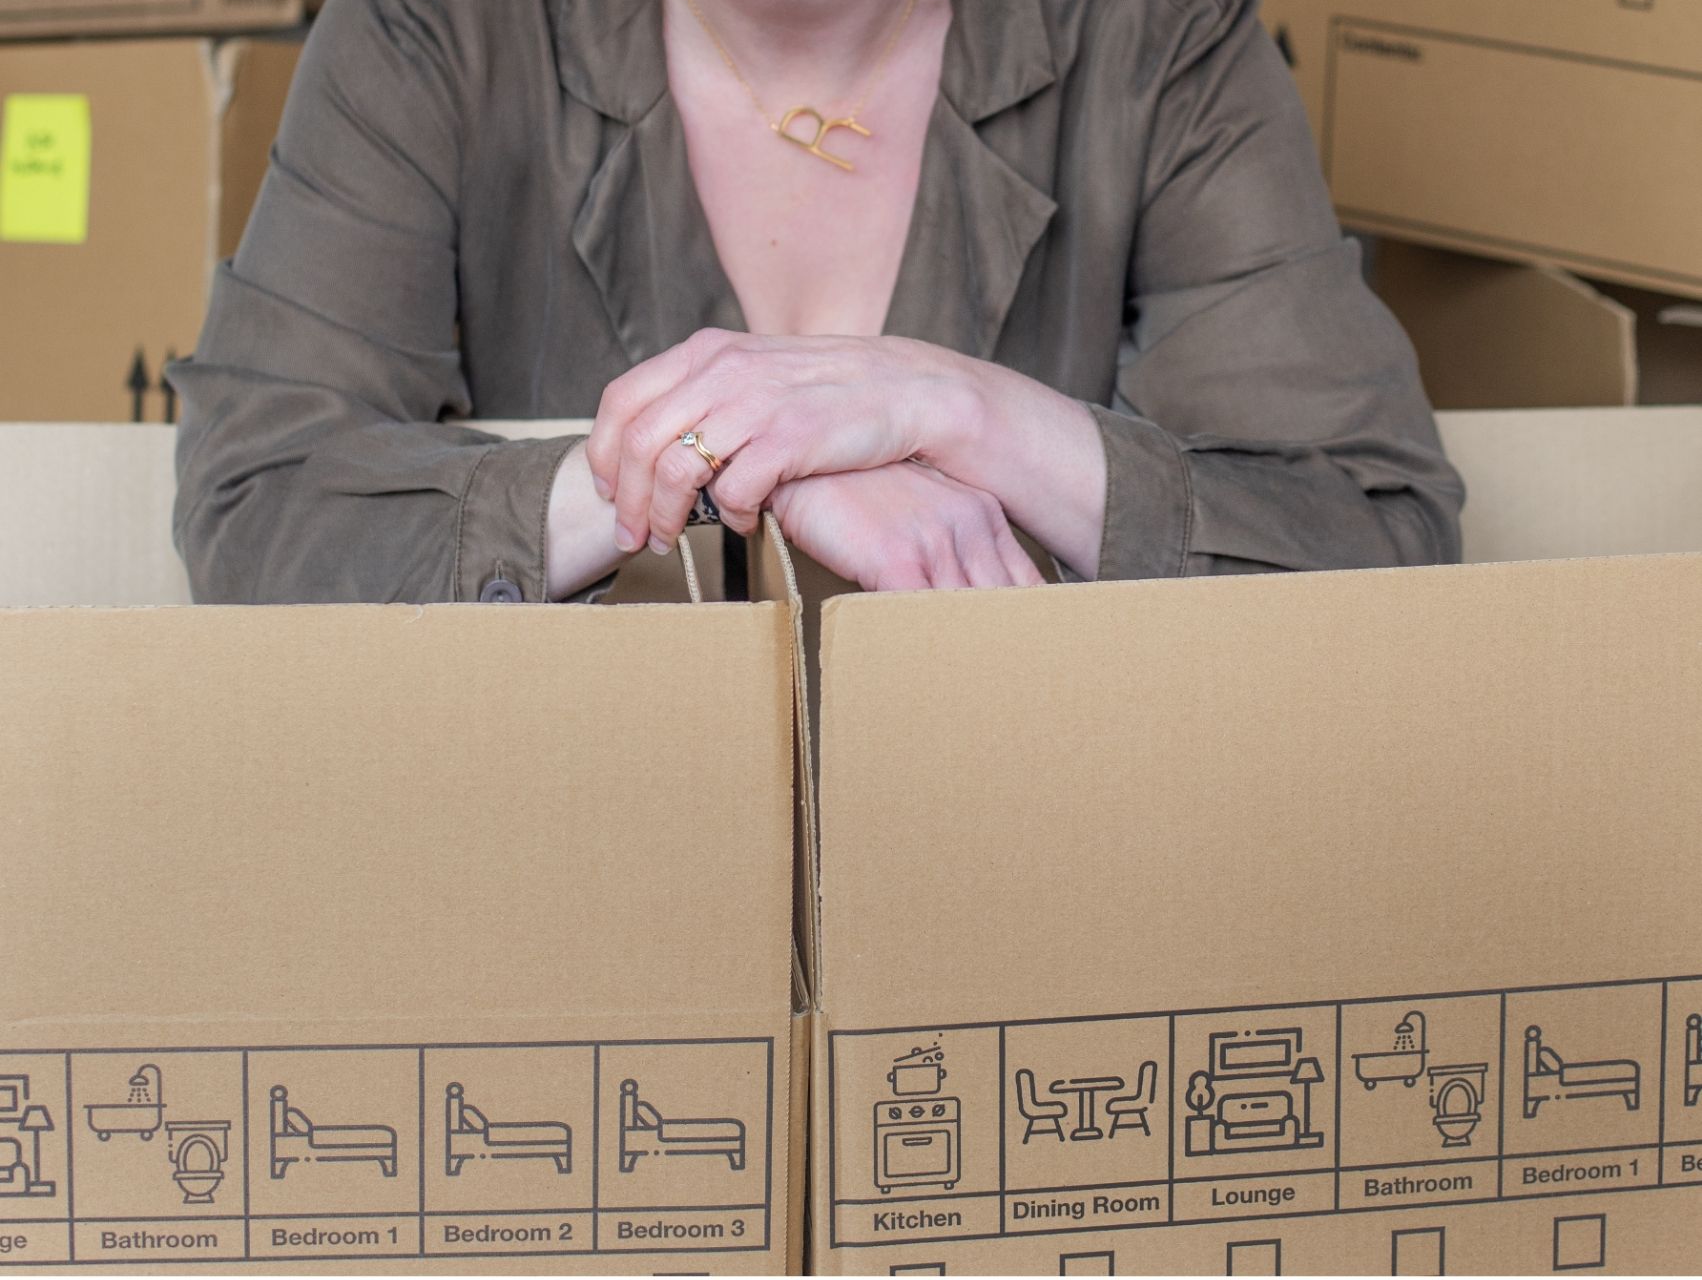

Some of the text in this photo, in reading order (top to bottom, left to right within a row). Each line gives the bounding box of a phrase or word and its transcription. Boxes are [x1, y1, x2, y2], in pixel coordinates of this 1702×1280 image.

[1522, 1158, 1639, 1185] Bedroom 1
[1211, 1186, 1296, 1207] Lounge
[1363, 1175, 1473, 1197] Bathroom
[1012, 1196, 1160, 1219] Dining Room
[617, 1218, 745, 1240] Bedroom 3
[873, 1210, 962, 1231] Kitchen
[101, 1230, 218, 1250] Bathroom
[271, 1226, 398, 1247] Bedroom 1
[443, 1222, 574, 1243] Bedroom 2
